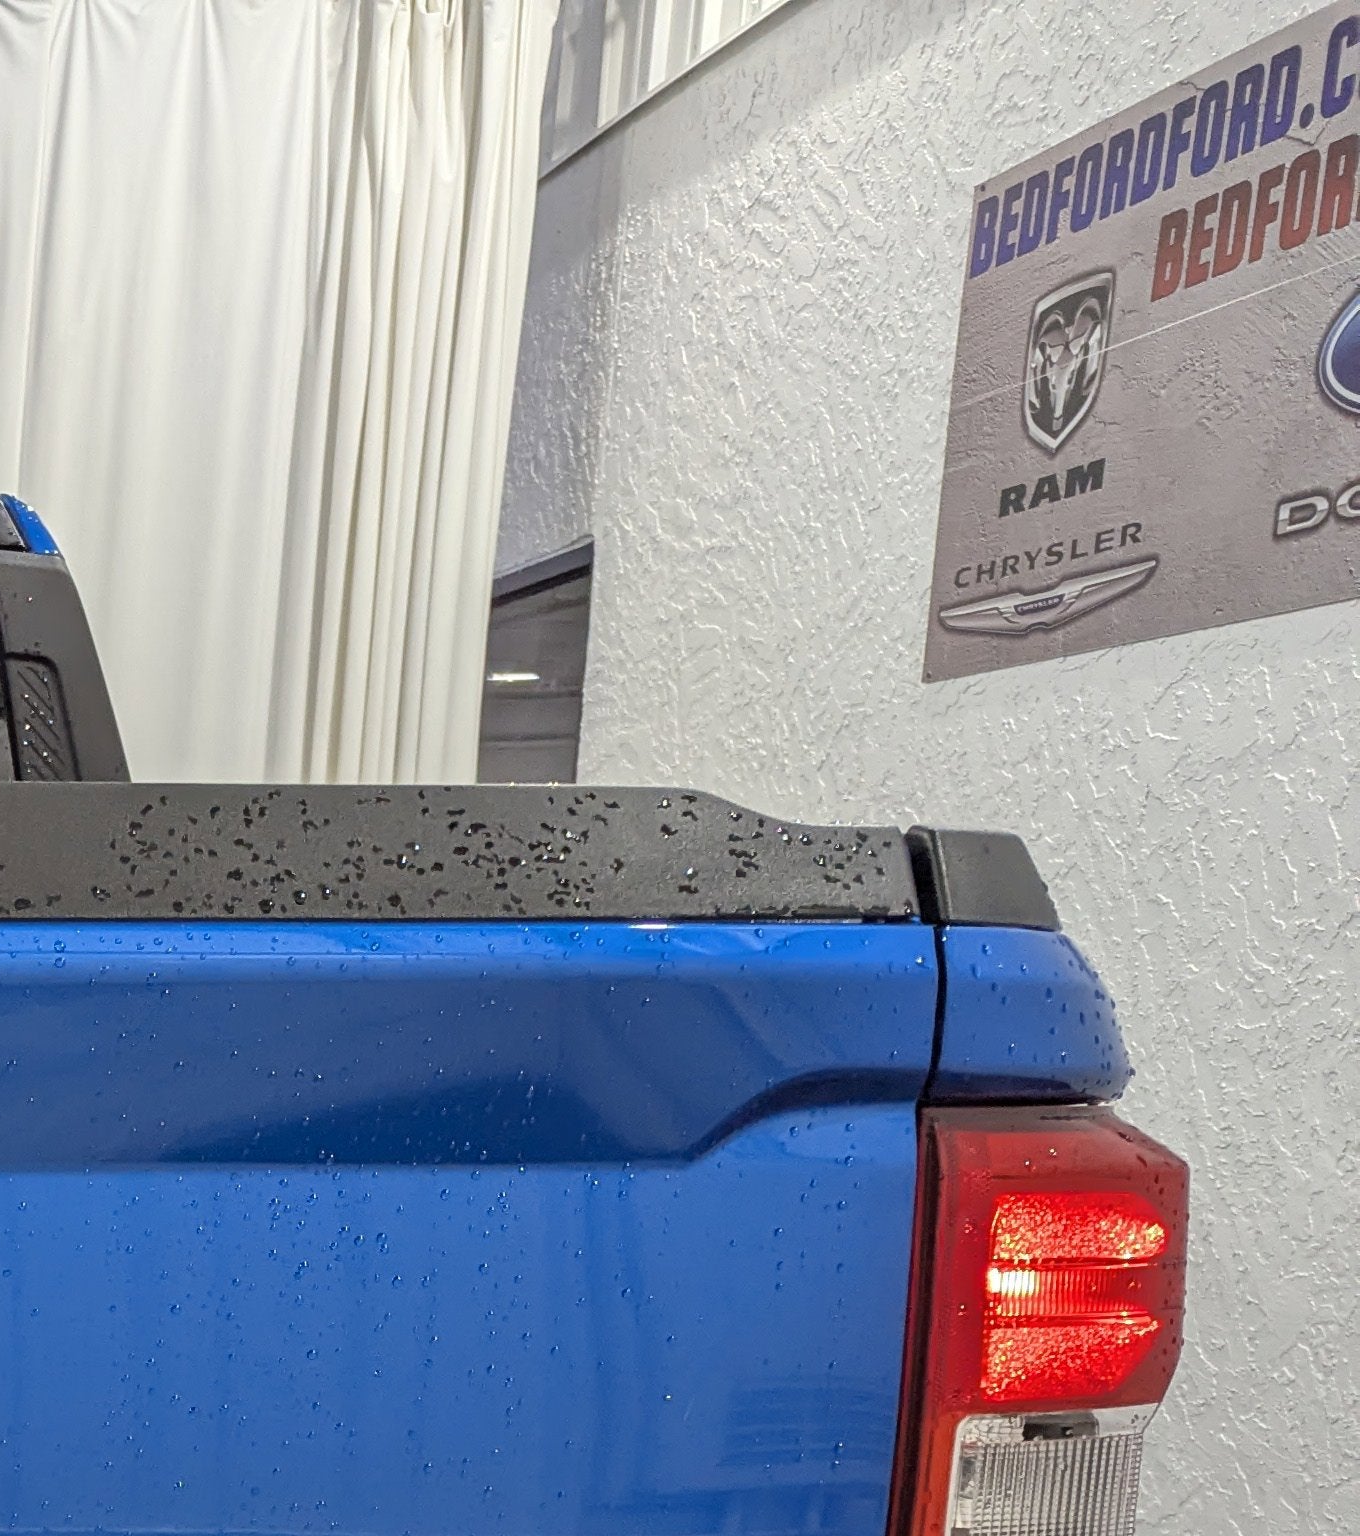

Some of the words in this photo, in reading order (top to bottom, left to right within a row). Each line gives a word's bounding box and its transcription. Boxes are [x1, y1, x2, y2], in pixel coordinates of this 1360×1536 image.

[969, 14, 1360, 280] BEDFORDFORD.C
[1150, 133, 1360, 302] BEDFOR
[998, 457, 1106, 518] RAM
[953, 521, 1143, 589] CHRYSLER
